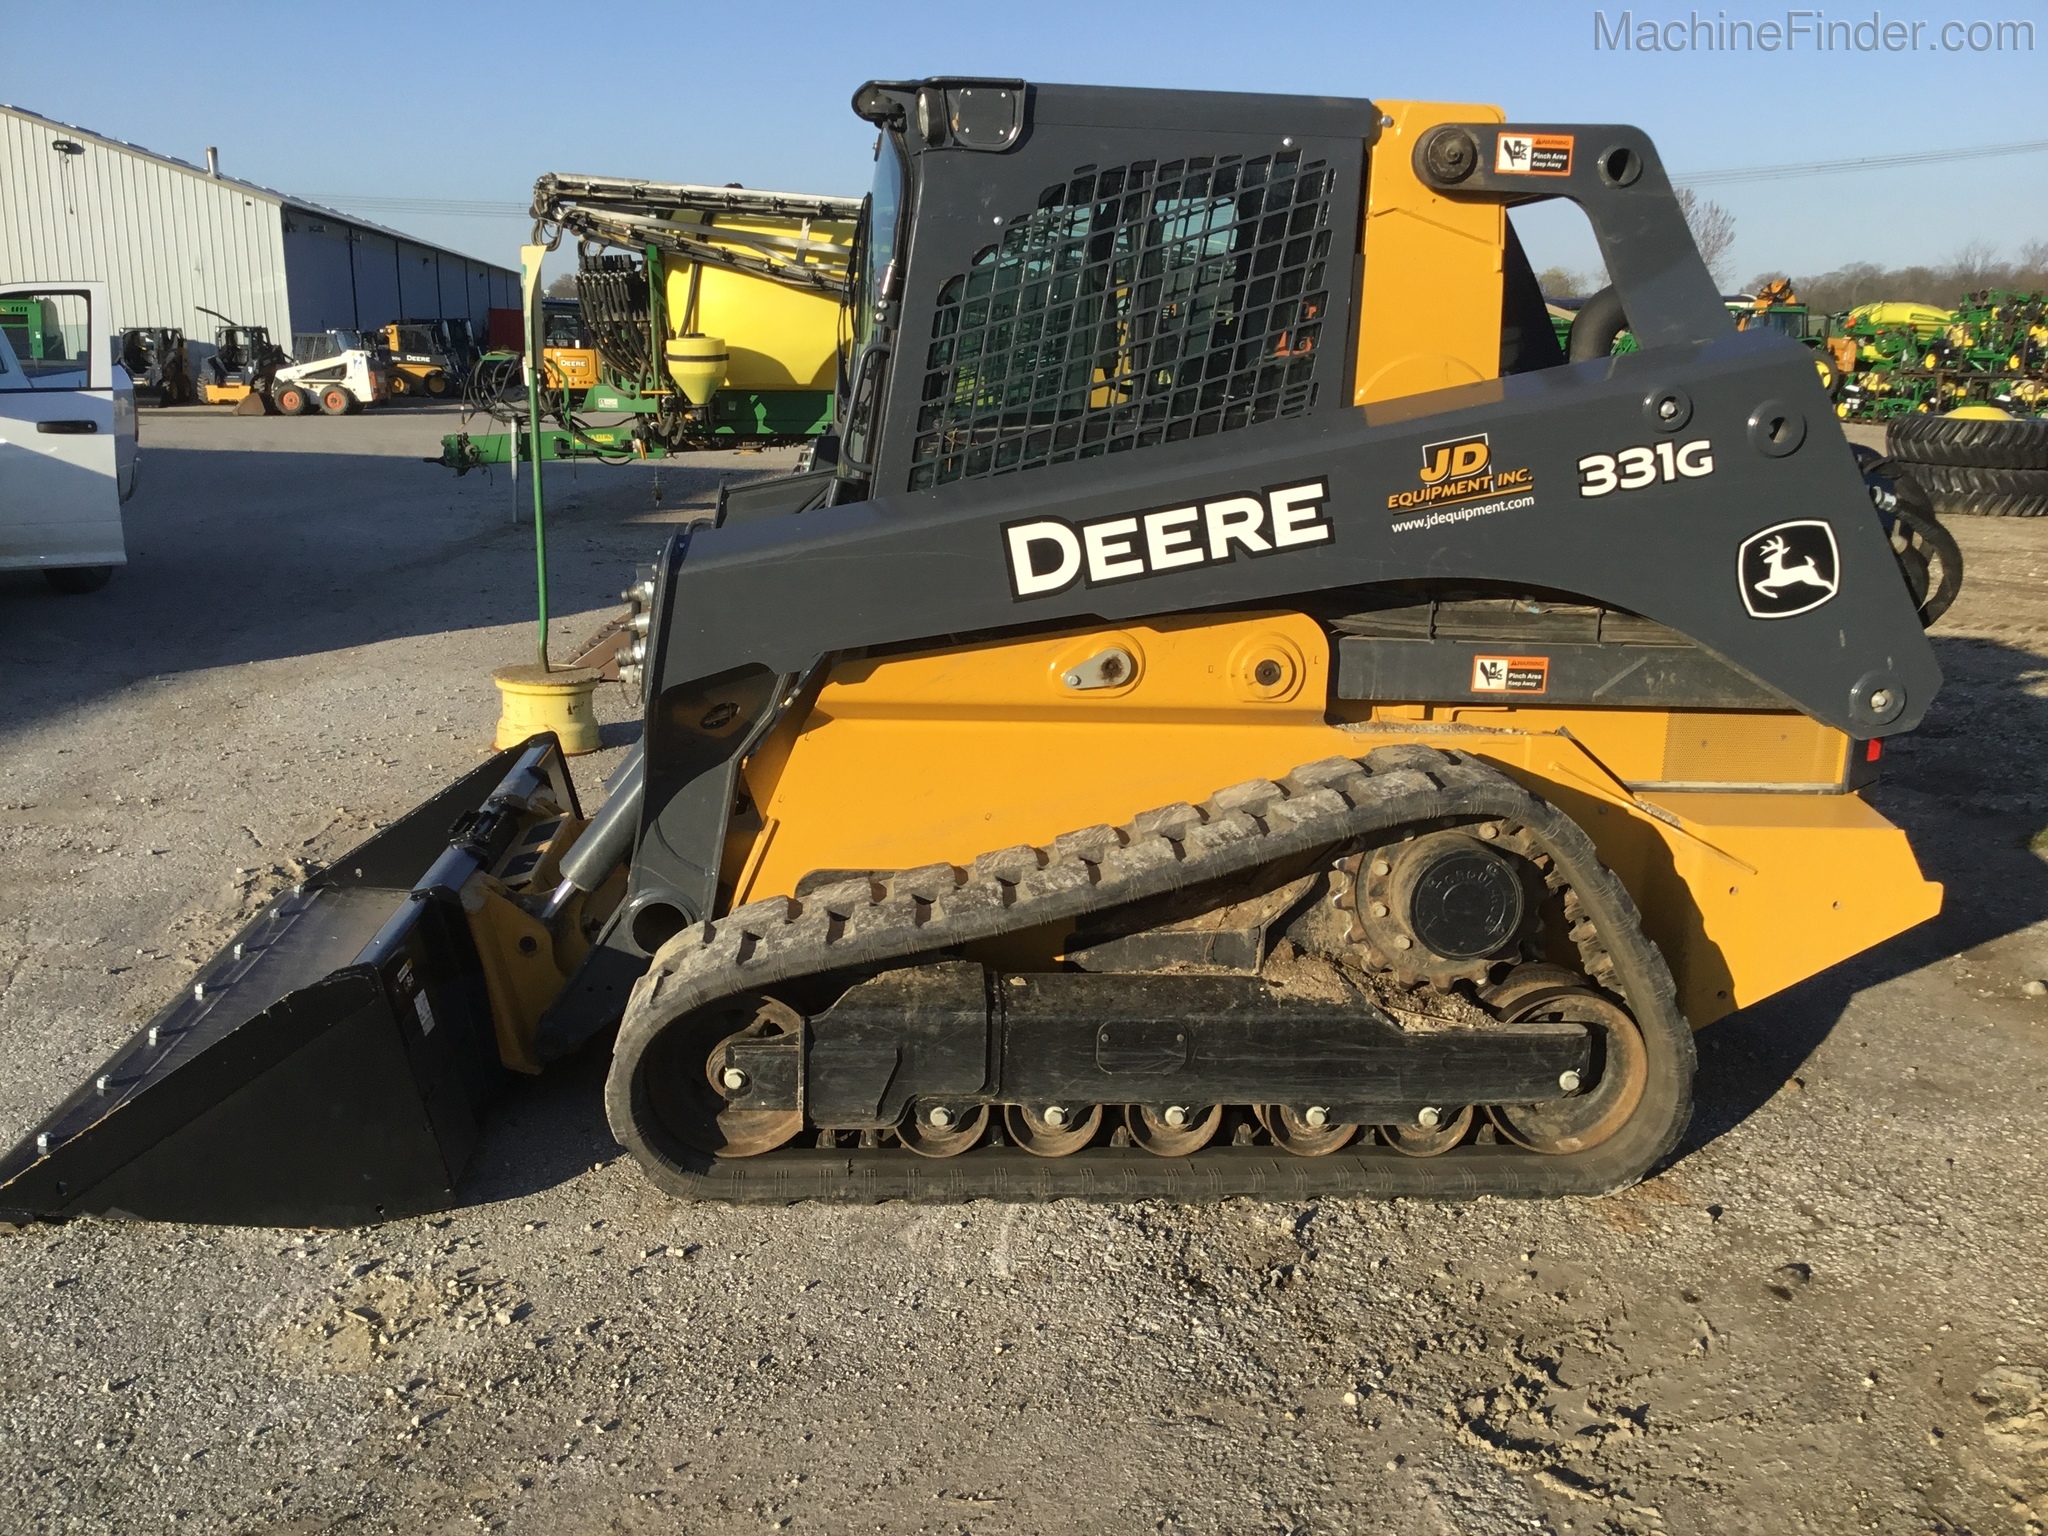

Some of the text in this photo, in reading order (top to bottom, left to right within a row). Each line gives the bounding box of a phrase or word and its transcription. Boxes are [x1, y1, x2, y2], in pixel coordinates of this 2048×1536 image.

[1532, 152, 1551, 160] Pinch
[1547, 161, 1562, 169] Away
[406, 354, 431, 363] DEERE
[1420, 442, 1490, 485] JD
[1578, 439, 1714, 497] 331G
[1387, 468, 1534, 509] EQUIPMENT INC.
[1391, 496, 1535, 533] www.jdequipment.com
[1007, 482, 1329, 596] DEERE
[1508, 672, 1527, 680] Pinch
